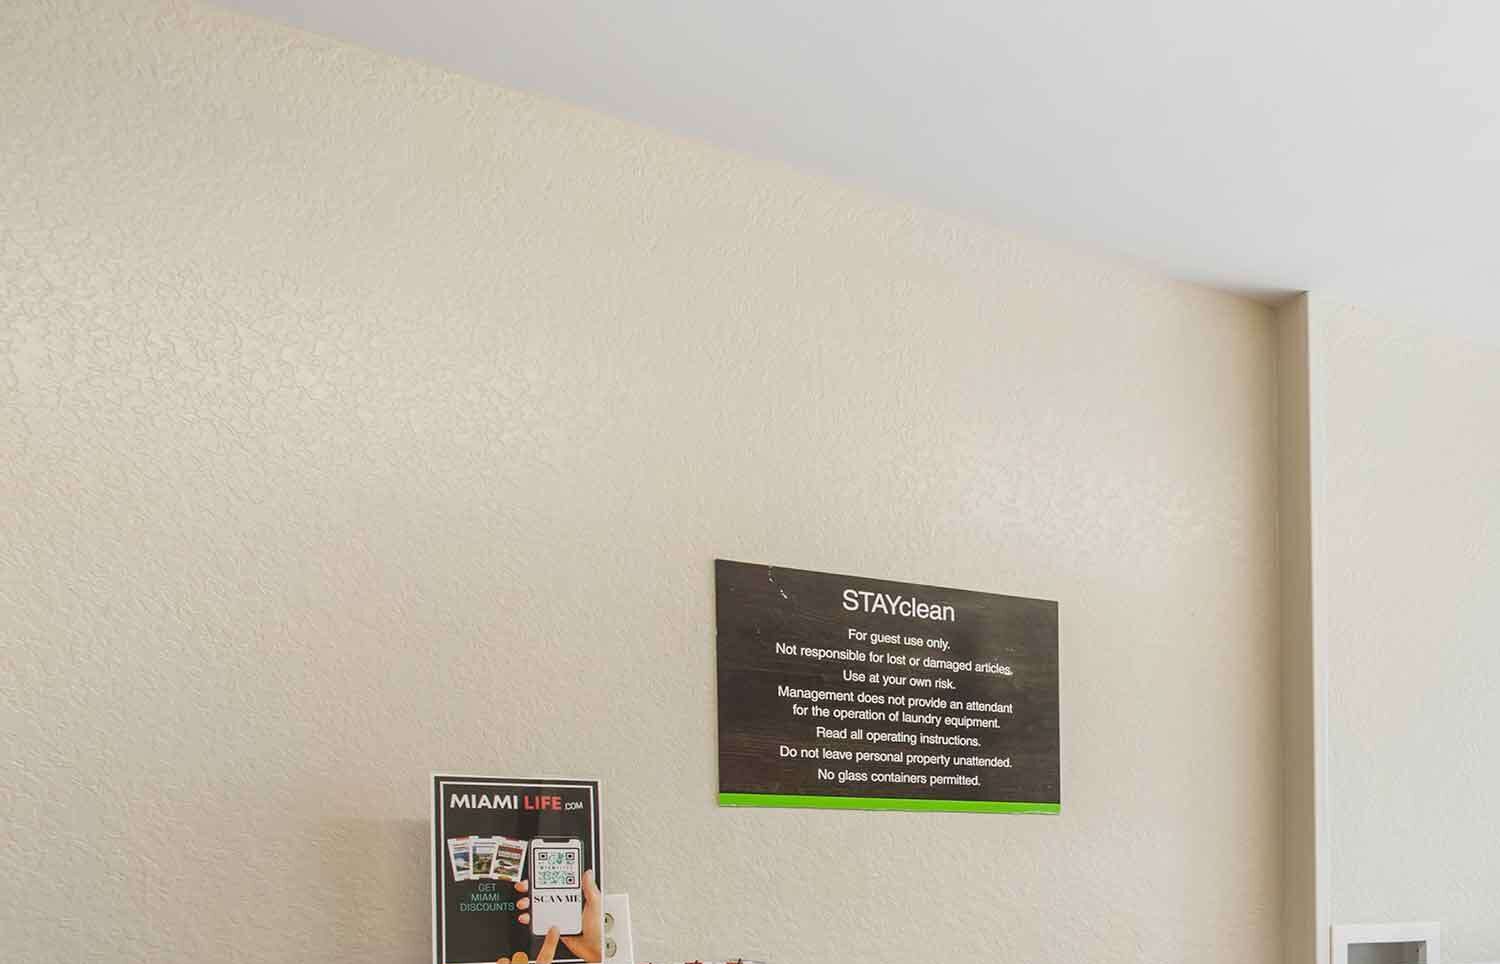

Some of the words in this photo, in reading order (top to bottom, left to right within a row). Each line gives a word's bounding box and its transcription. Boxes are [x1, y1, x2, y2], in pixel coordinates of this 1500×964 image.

[842, 589, 955, 622] STAYclean
[848, 628, 868, 641] For
[870, 633, 901, 645] guest
[903, 636, 924, 647] use
[926, 637, 951, 652] only.
[775, 642, 797, 656] Not
[800, 647, 866, 662] responsible
[868, 651, 885, 663] for
[886, 652, 906, 666] lost
[908, 657, 921, 667] or
[922, 656, 972, 673] damaged
[974, 662, 1014, 676] articles.
[843, 669, 866, 682] Use
[869, 672, 880, 684] at
[882, 675, 907, 687] your
[909, 677, 932, 688] own
[934, 678, 956, 690] risk.
[778, 685, 855, 702] Management
[857, 691, 885, 704] does
[888, 695, 906, 706] not
[908, 697, 947, 709] provide
[949, 701, 963, 710] an
[966, 701, 1013, 714] attendant
[792, 703, 809, 716] for
[811, 705, 830, 718] the
[833, 709, 886, 721] operation
[888, 711, 899, 722] of
[902, 711, 942, 727] laundry
[944, 715, 1001, 729] equipment.
[816, 726, 847, 739] Read
[850, 728, 863, 740] all
[866, 731, 917, 746] operating
[919, 732, 981, 747] instructions.
[780, 745, 798, 758] Do
[800, 748, 819, 759] not
[822, 747, 853, 761] leave
[855, 751, 903, 763] personal
[906, 754, 951, 767] property
[953, 756, 1013, 768] unattended.
[817, 768, 835, 780] No
[838, 769, 868, 784] glass
[870, 771, 927, 784] containers
[929, 774, 981, 787] permitted.
[450, 793, 518, 810] MIAMI
[523, 795, 561, 811] LIFE
[471, 893, 499, 903] MIAMI
[478, 882, 497, 893] GET
[459, 902, 516, 913] DISCOUNTS
